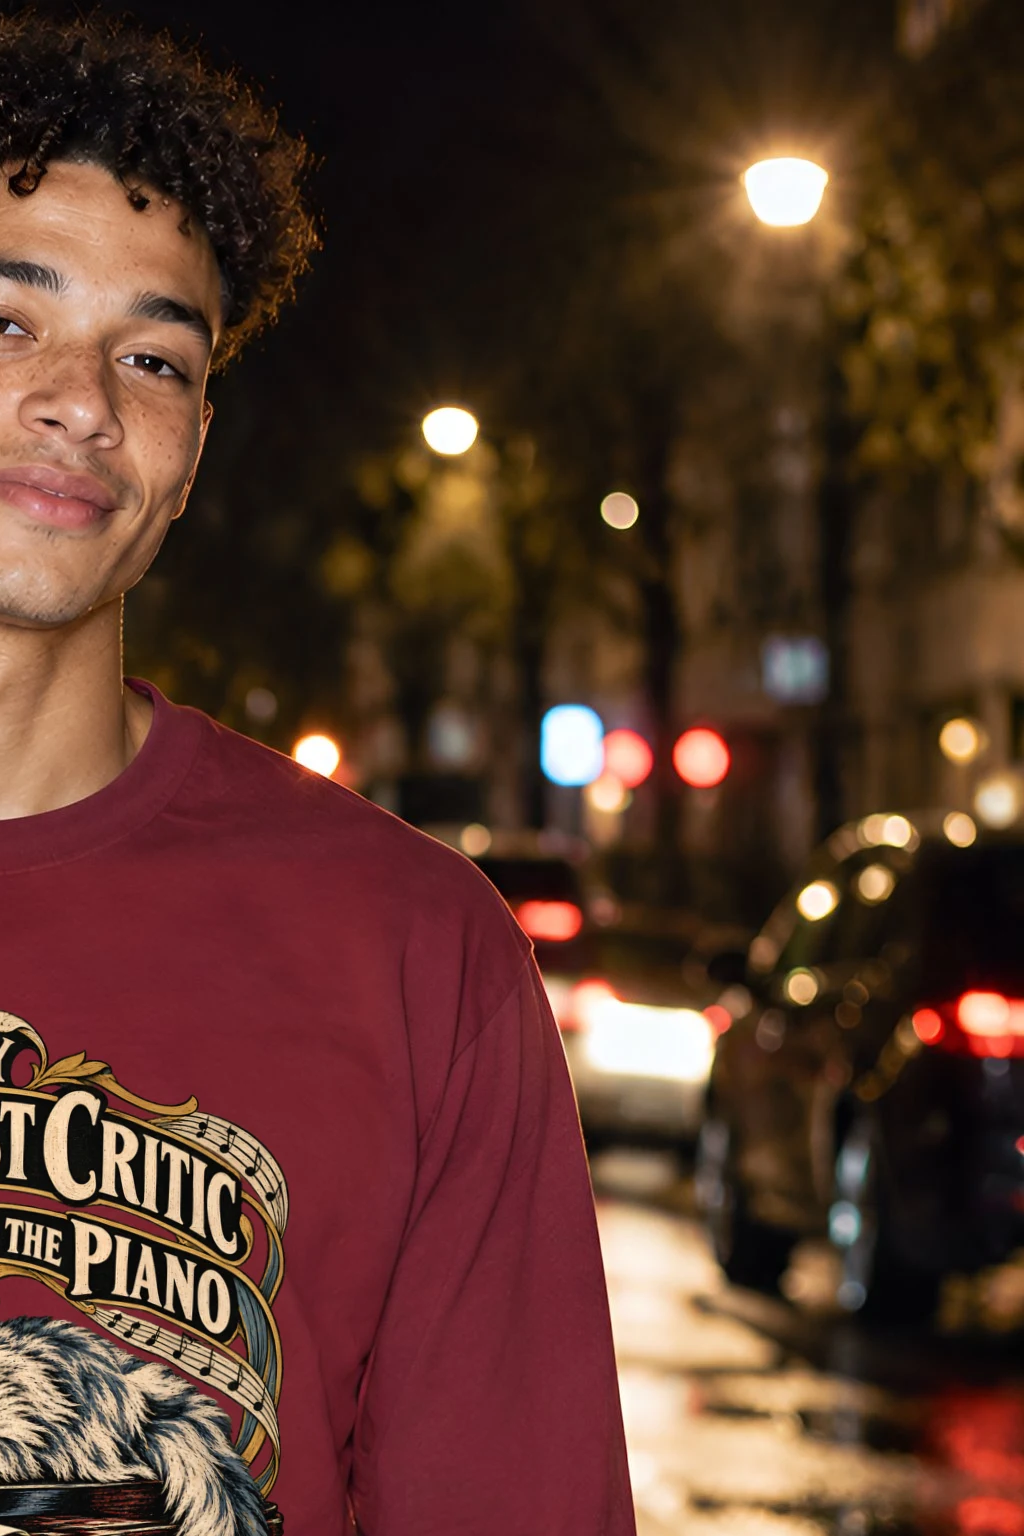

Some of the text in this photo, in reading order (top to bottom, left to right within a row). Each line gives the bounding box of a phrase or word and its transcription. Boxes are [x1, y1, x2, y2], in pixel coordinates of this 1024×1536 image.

[42, 1090, 238, 1254] CRITIC
[4, 1221, 63, 1267] THE
[69, 1218, 231, 1335] PIANO
